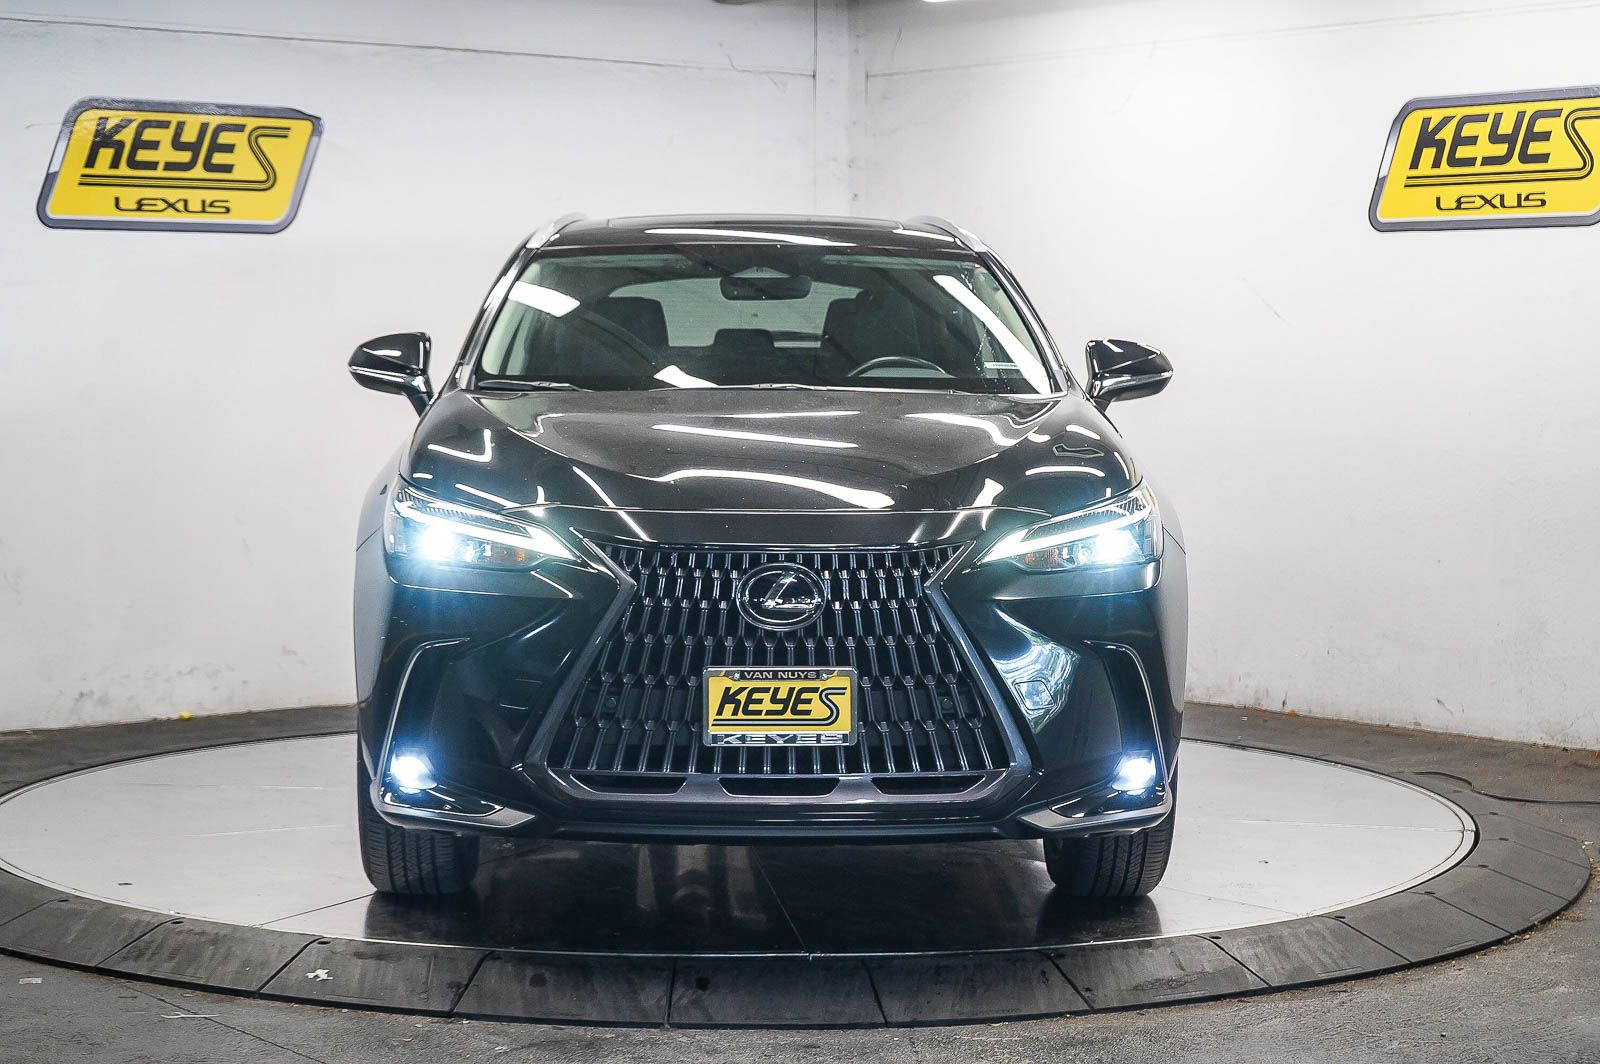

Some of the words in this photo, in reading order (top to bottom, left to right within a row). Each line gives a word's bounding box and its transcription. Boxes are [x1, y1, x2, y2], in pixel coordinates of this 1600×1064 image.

[78, 116, 291, 191] KEYES
[1404, 107, 1600, 187] KEYES
[114, 196, 231, 214] LEXUS
[1436, 192, 1547, 211] LEXUS
[744, 671, 773, 679] VAN
[777, 671, 817, 679] NUYS
[712, 686, 848, 726] KEYES
[716, 733, 844, 744] KEYES
